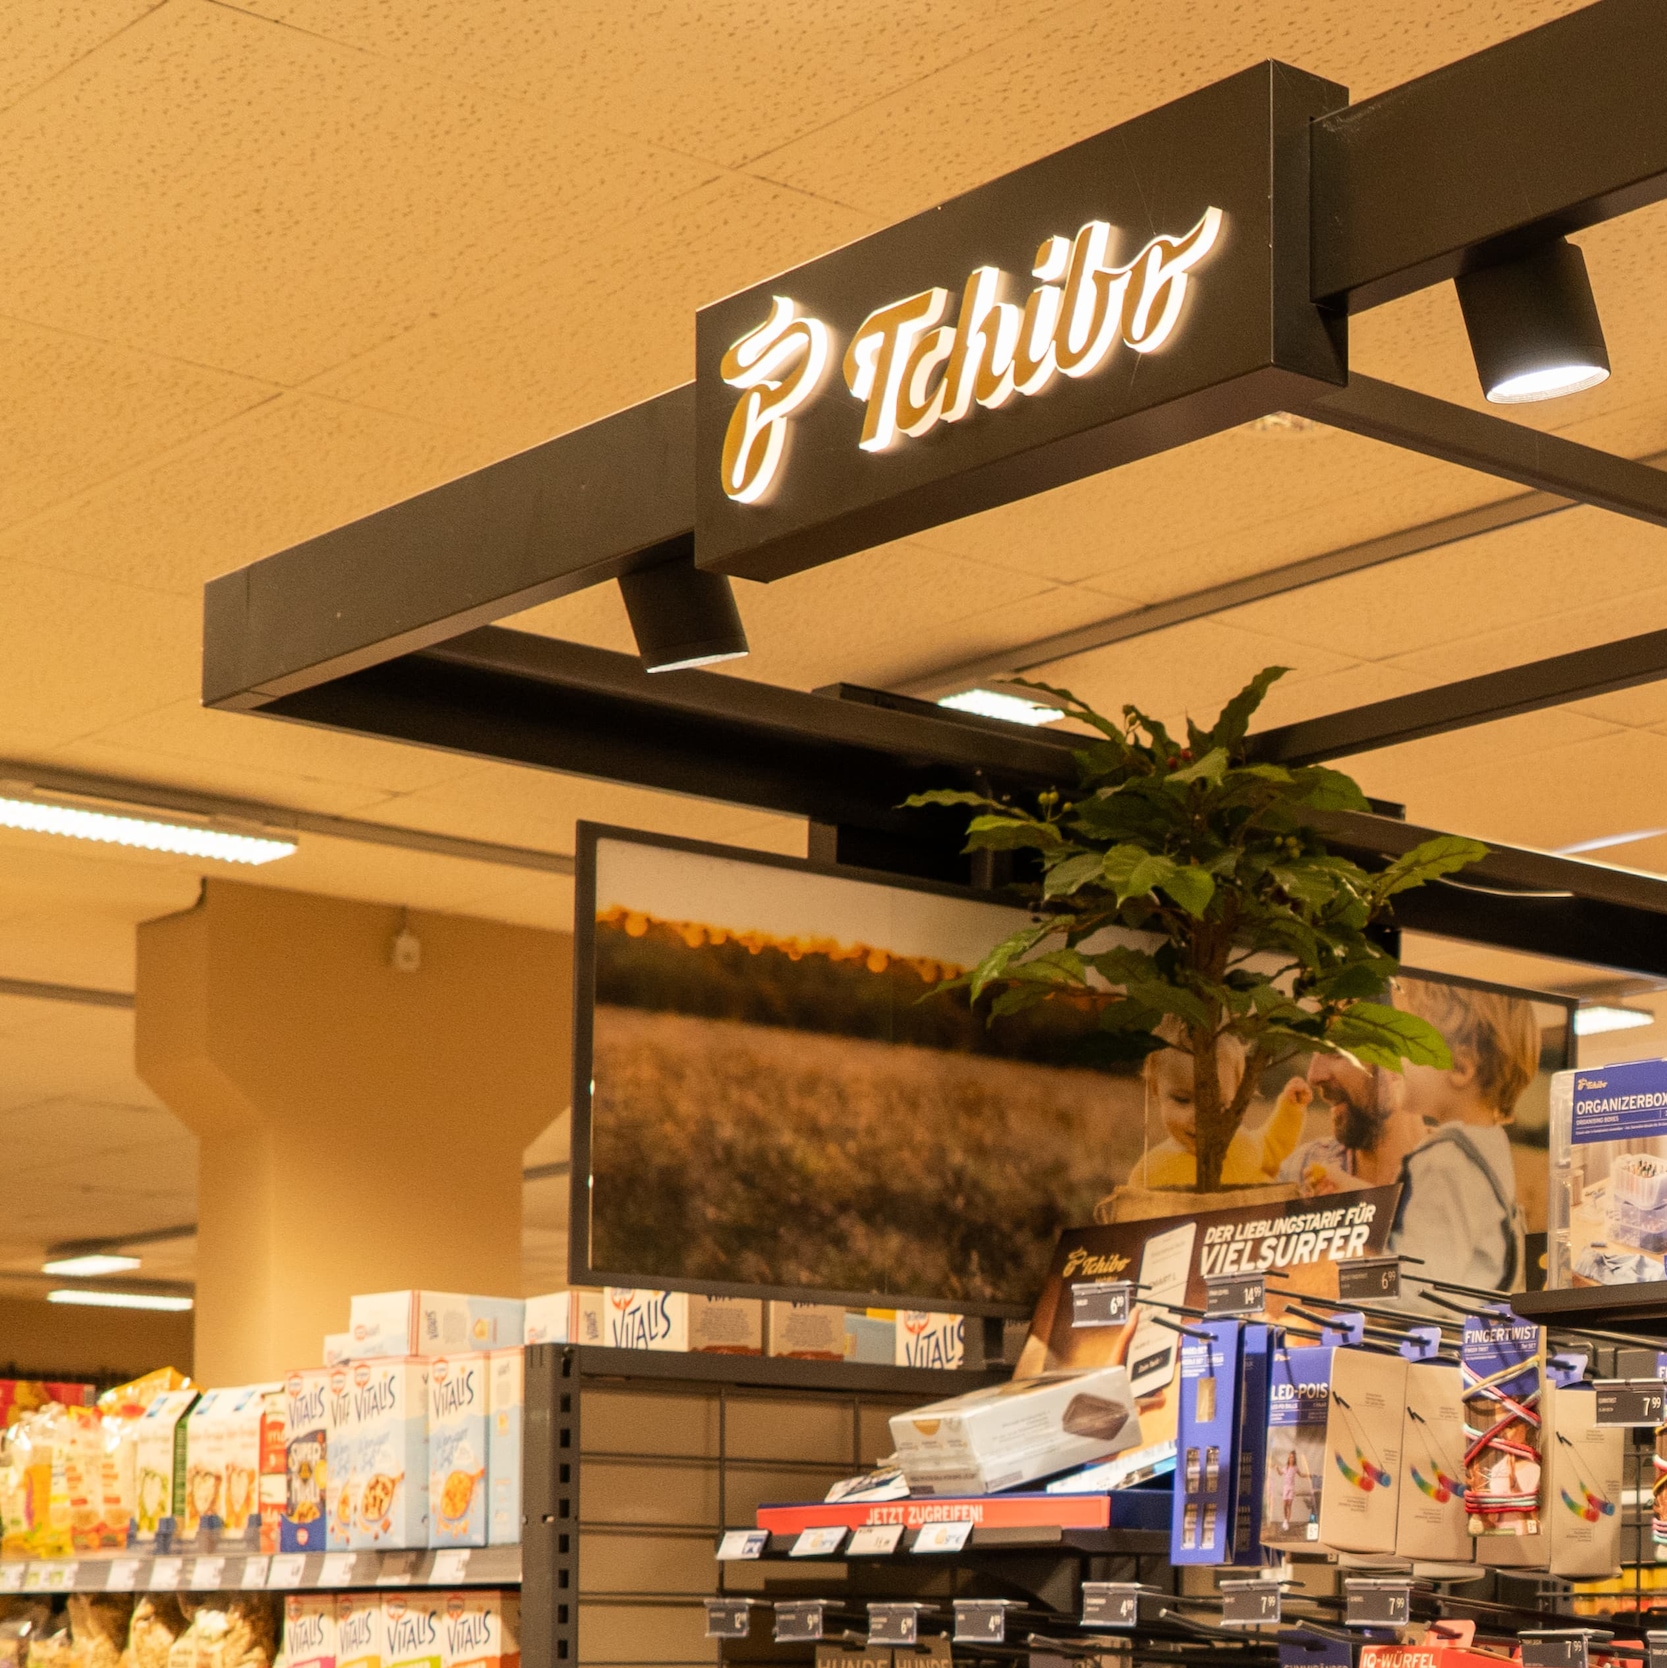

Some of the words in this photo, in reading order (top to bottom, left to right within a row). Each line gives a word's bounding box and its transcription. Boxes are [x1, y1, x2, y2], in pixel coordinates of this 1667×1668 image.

[842, 205, 1224, 452] Tchibo
[1204, 1225, 1234, 1245] DER
[1237, 1212, 1343, 1240] LIEBLINGSTARIF
[1344, 1202, 1376, 1224] FÜR
[1201, 1225, 1370, 1276] VIELSURFER
[1465, 1327, 1537, 1344] FINGERTWIST
[867, 1506, 905, 1527] JETZT
[908, 1500, 983, 1524] ZUGREIFEN!
